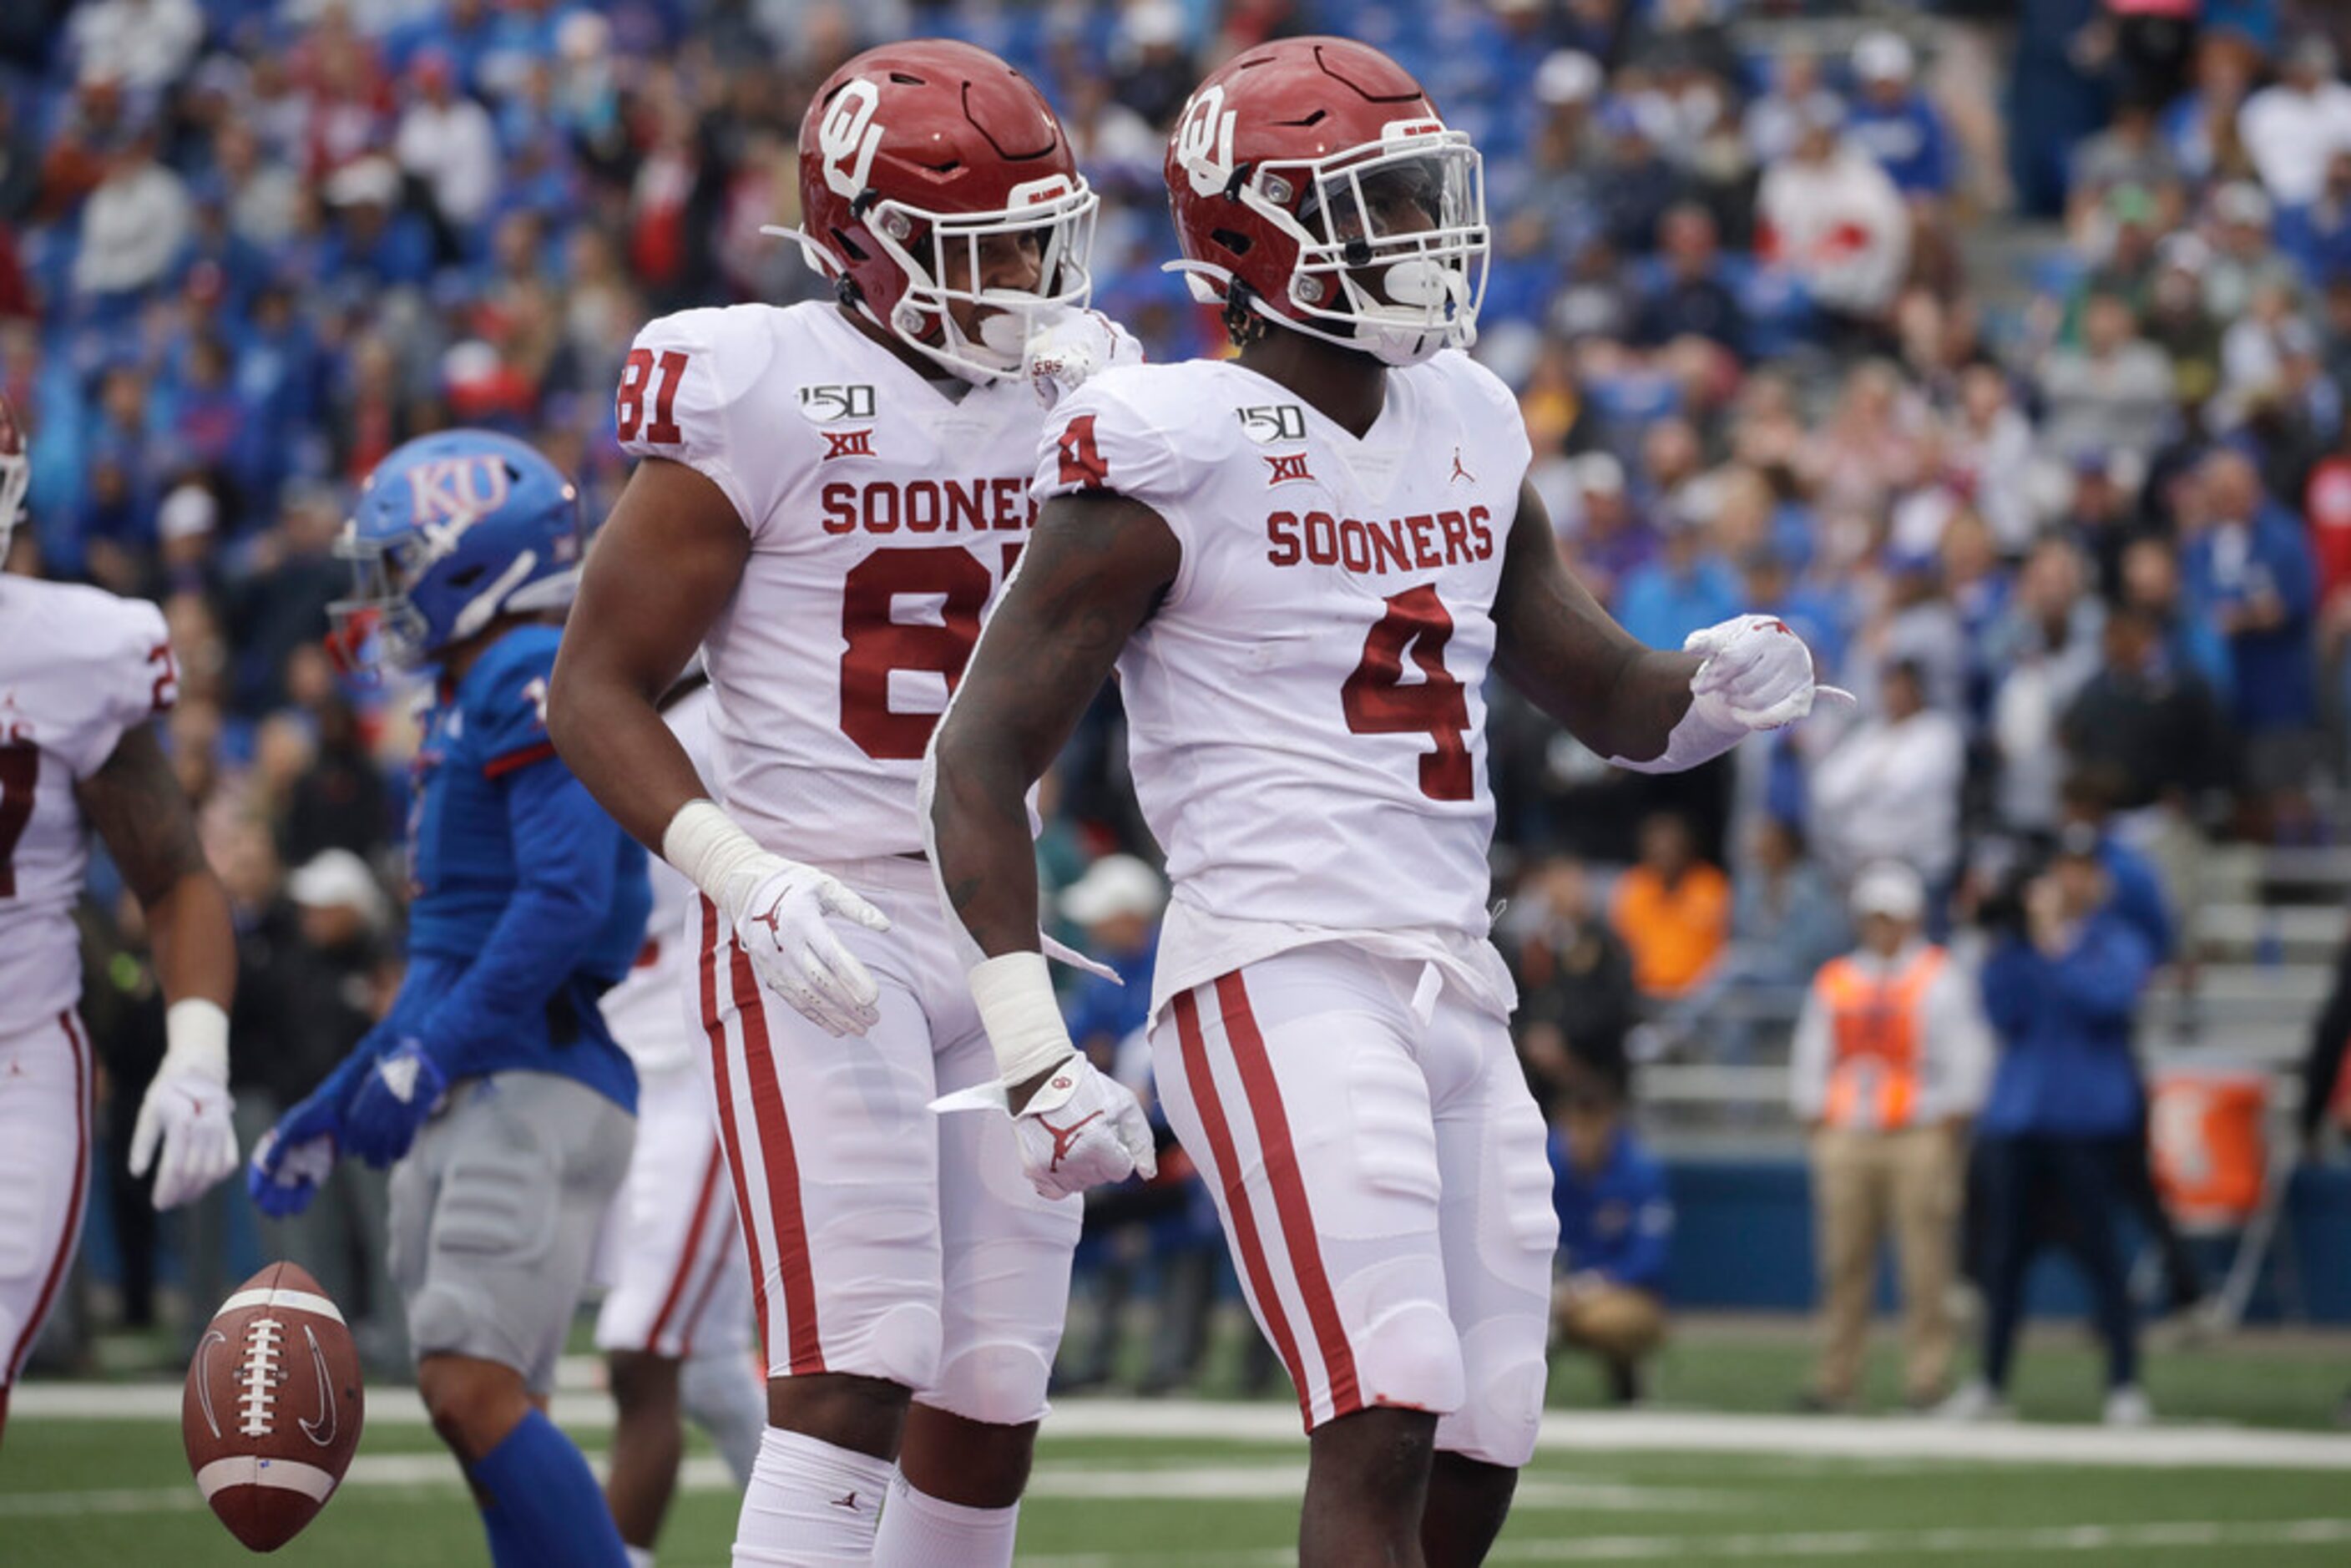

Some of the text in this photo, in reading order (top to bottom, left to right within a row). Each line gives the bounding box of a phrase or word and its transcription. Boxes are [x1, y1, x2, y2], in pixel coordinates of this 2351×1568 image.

[617, 348, 689, 443] 81
[820, 428, 877, 461] XII
[1058, 415, 1109, 490] 4
[1262, 452, 1316, 485] XII
[406, 454, 510, 526] KU
[1267, 505, 1493, 574] SOONERS
[840, 543, 1027, 759] 8
[1341, 582, 1474, 801] 4
